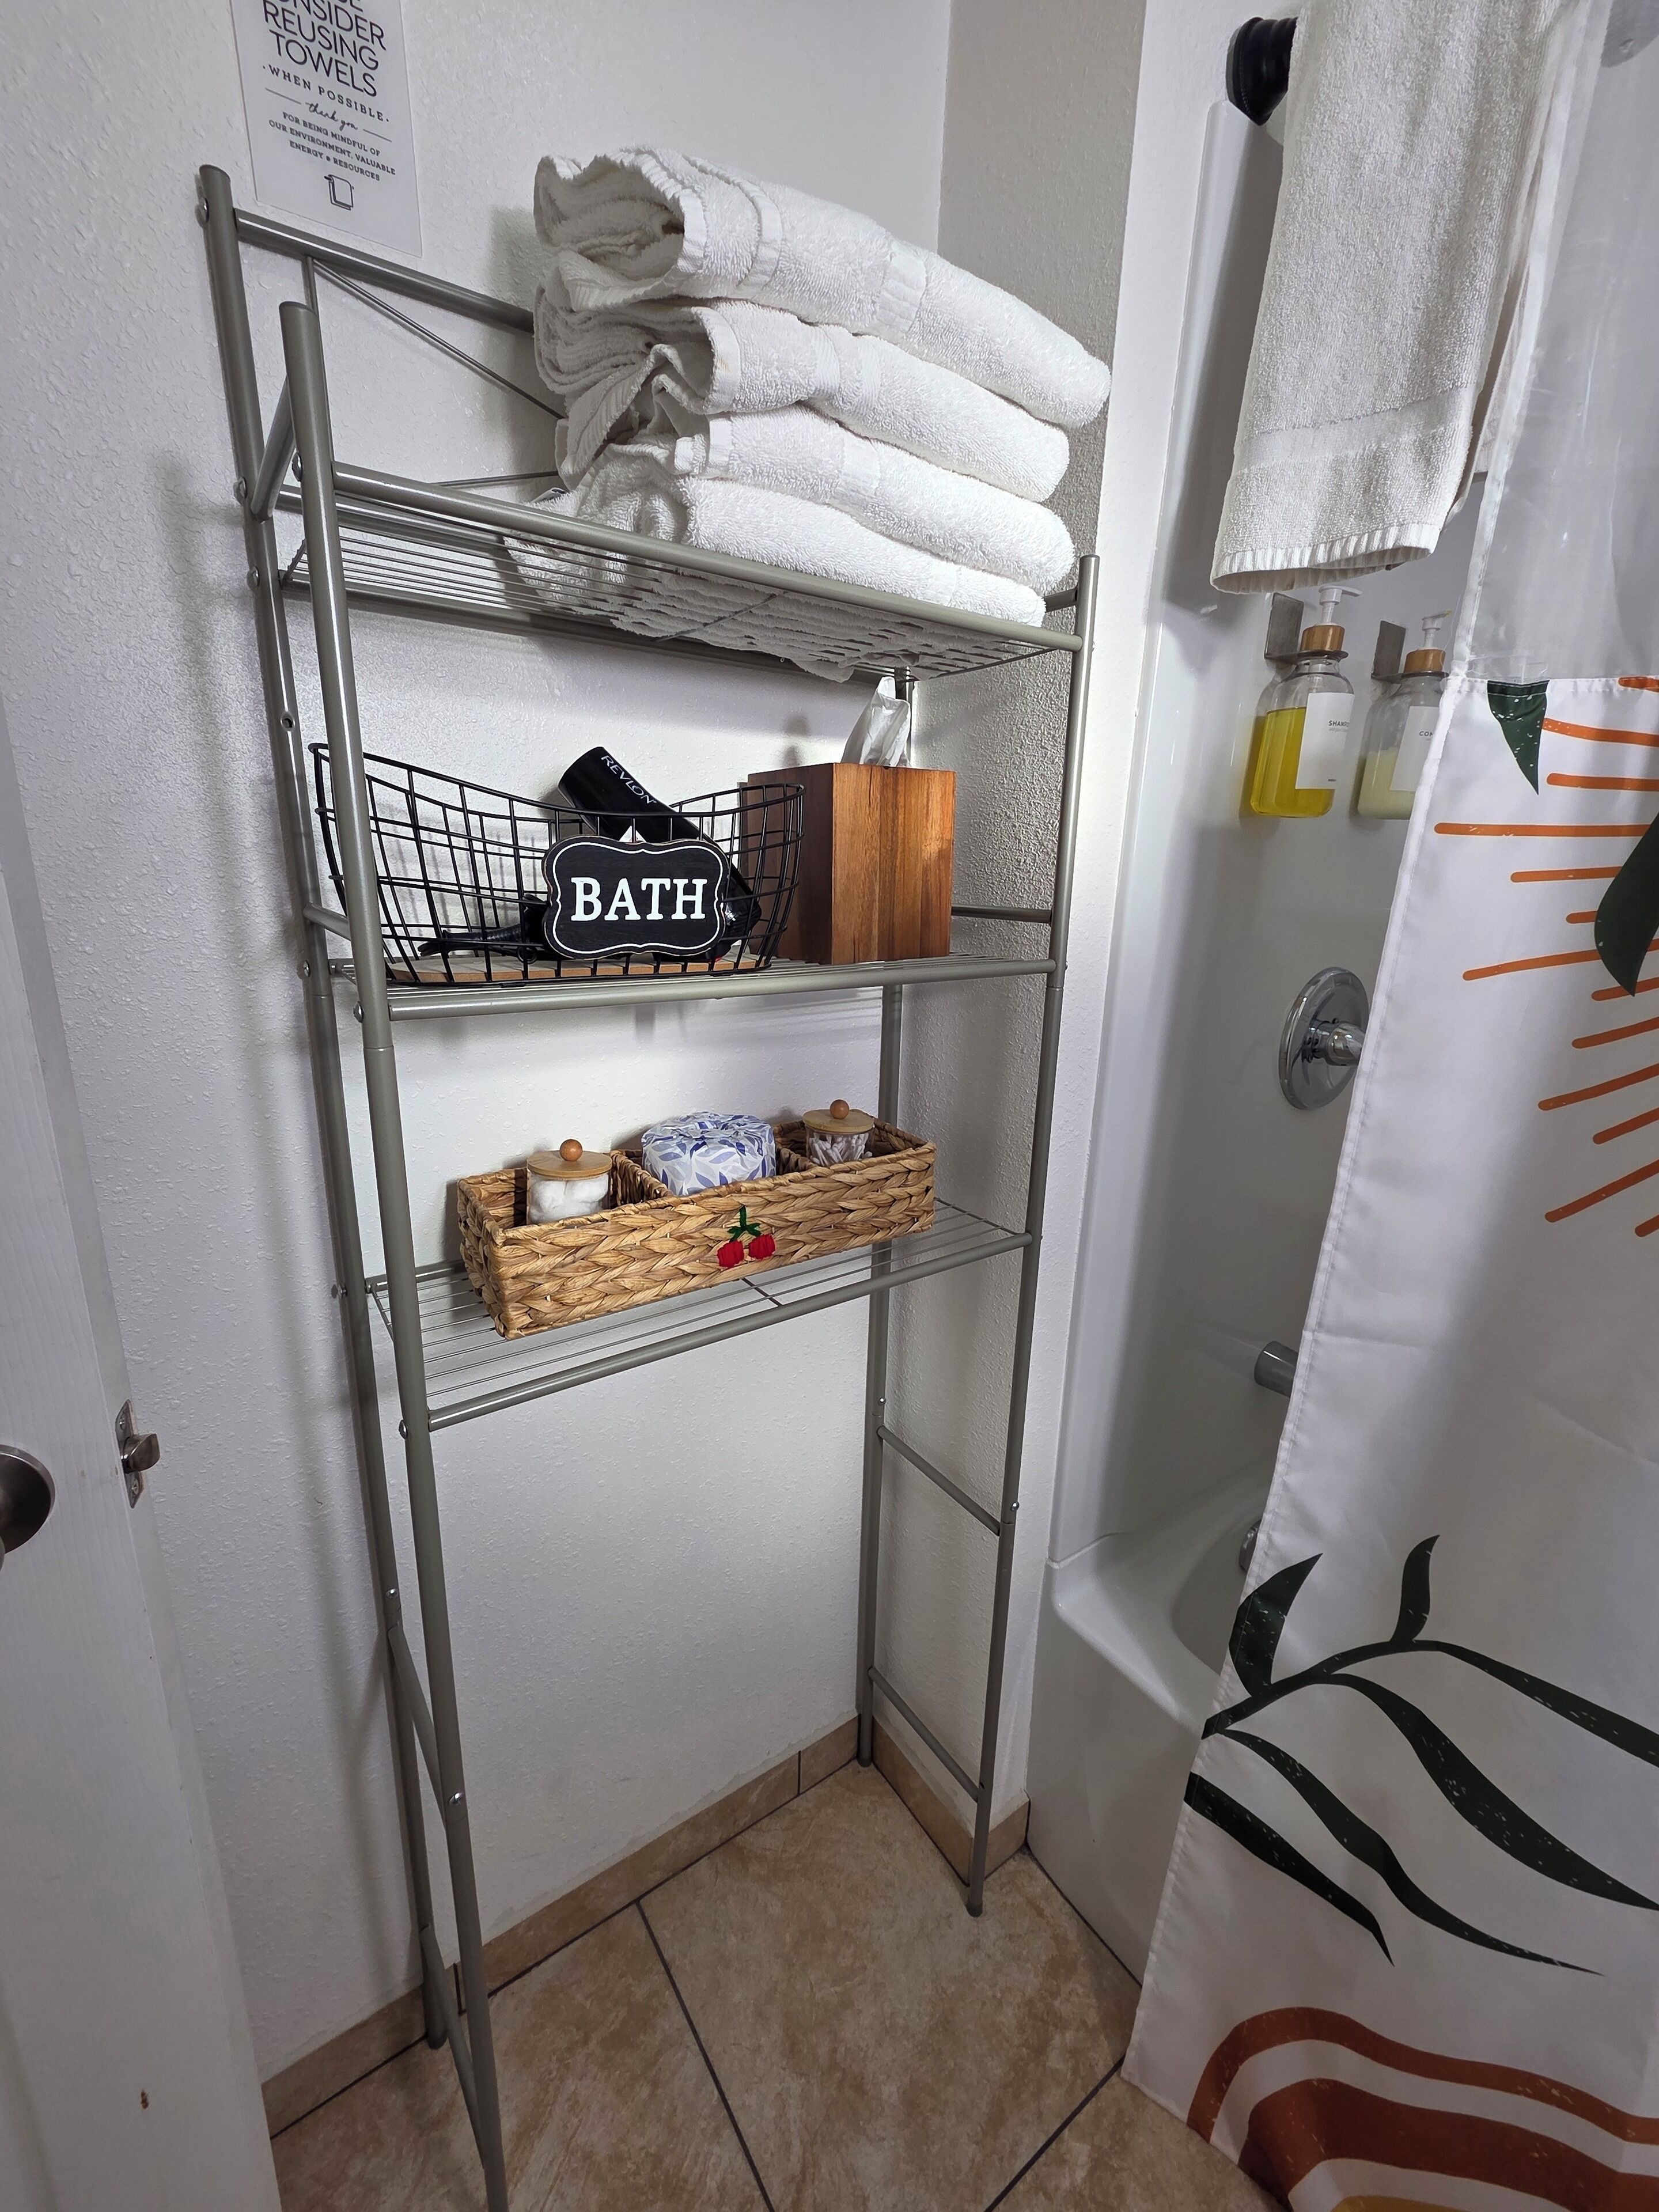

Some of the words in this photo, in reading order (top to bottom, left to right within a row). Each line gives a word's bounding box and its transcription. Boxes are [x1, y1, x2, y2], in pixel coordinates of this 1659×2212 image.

[263, 0, 379, 70] REUSING
[279, 0, 387, 51] SIDER
[268, 64, 312, 90] WHEN
[269, 29, 377, 97] TOWELS
[268, 119, 287, 132] OUR
[355, 153, 396, 175] VALUABLE
[282, 112, 300, 125] FOR
[302, 119, 328, 137] BEING
[331, 131, 368, 152] MINDFUL
[370, 147, 381, 157] OF
[289, 140, 324, 159] ENERGY
[333, 157, 380, 181] RESOURCES
[601, 755, 654, 804] REVLON
[570, 877, 708, 922] BATH
